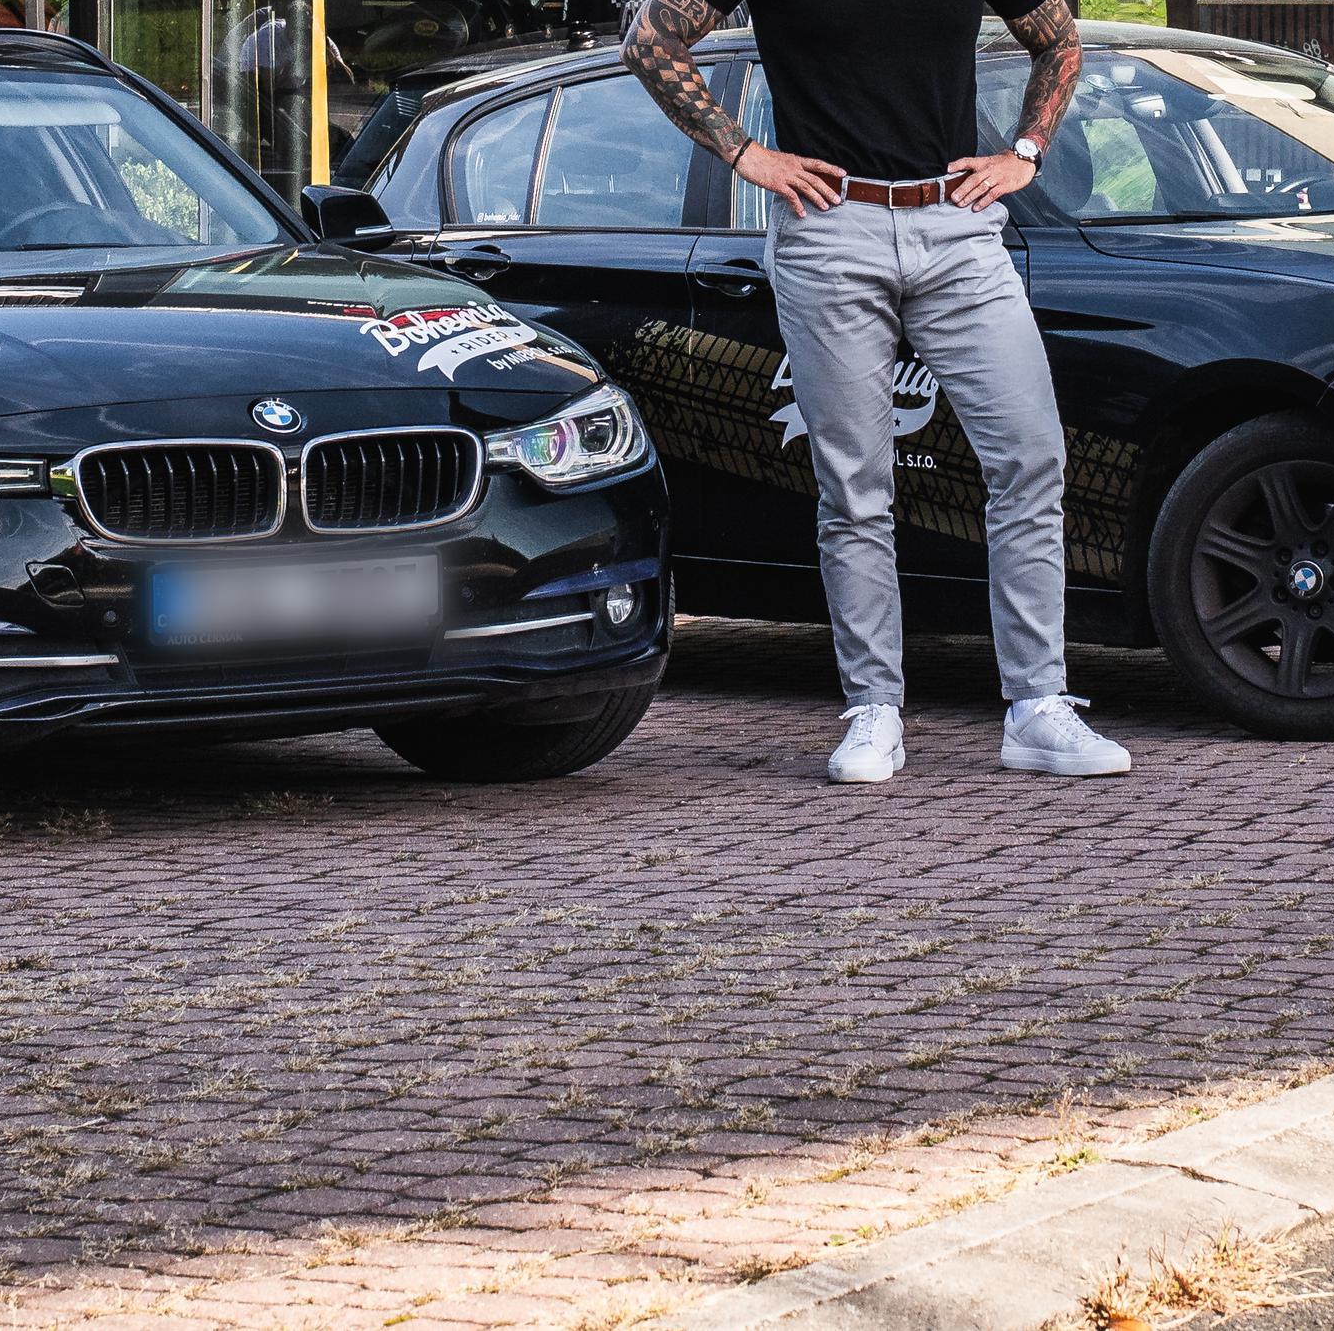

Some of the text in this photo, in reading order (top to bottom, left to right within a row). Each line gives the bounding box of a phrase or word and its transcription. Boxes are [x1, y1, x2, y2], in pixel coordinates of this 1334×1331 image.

[359, 301, 511, 357] Bohemia
[458, 330, 509, 352] RIDER
[486, 358, 513, 371] by
[503, 347, 551, 366] MIRPOL
[906, 454, 937, 469] s.r.o.
